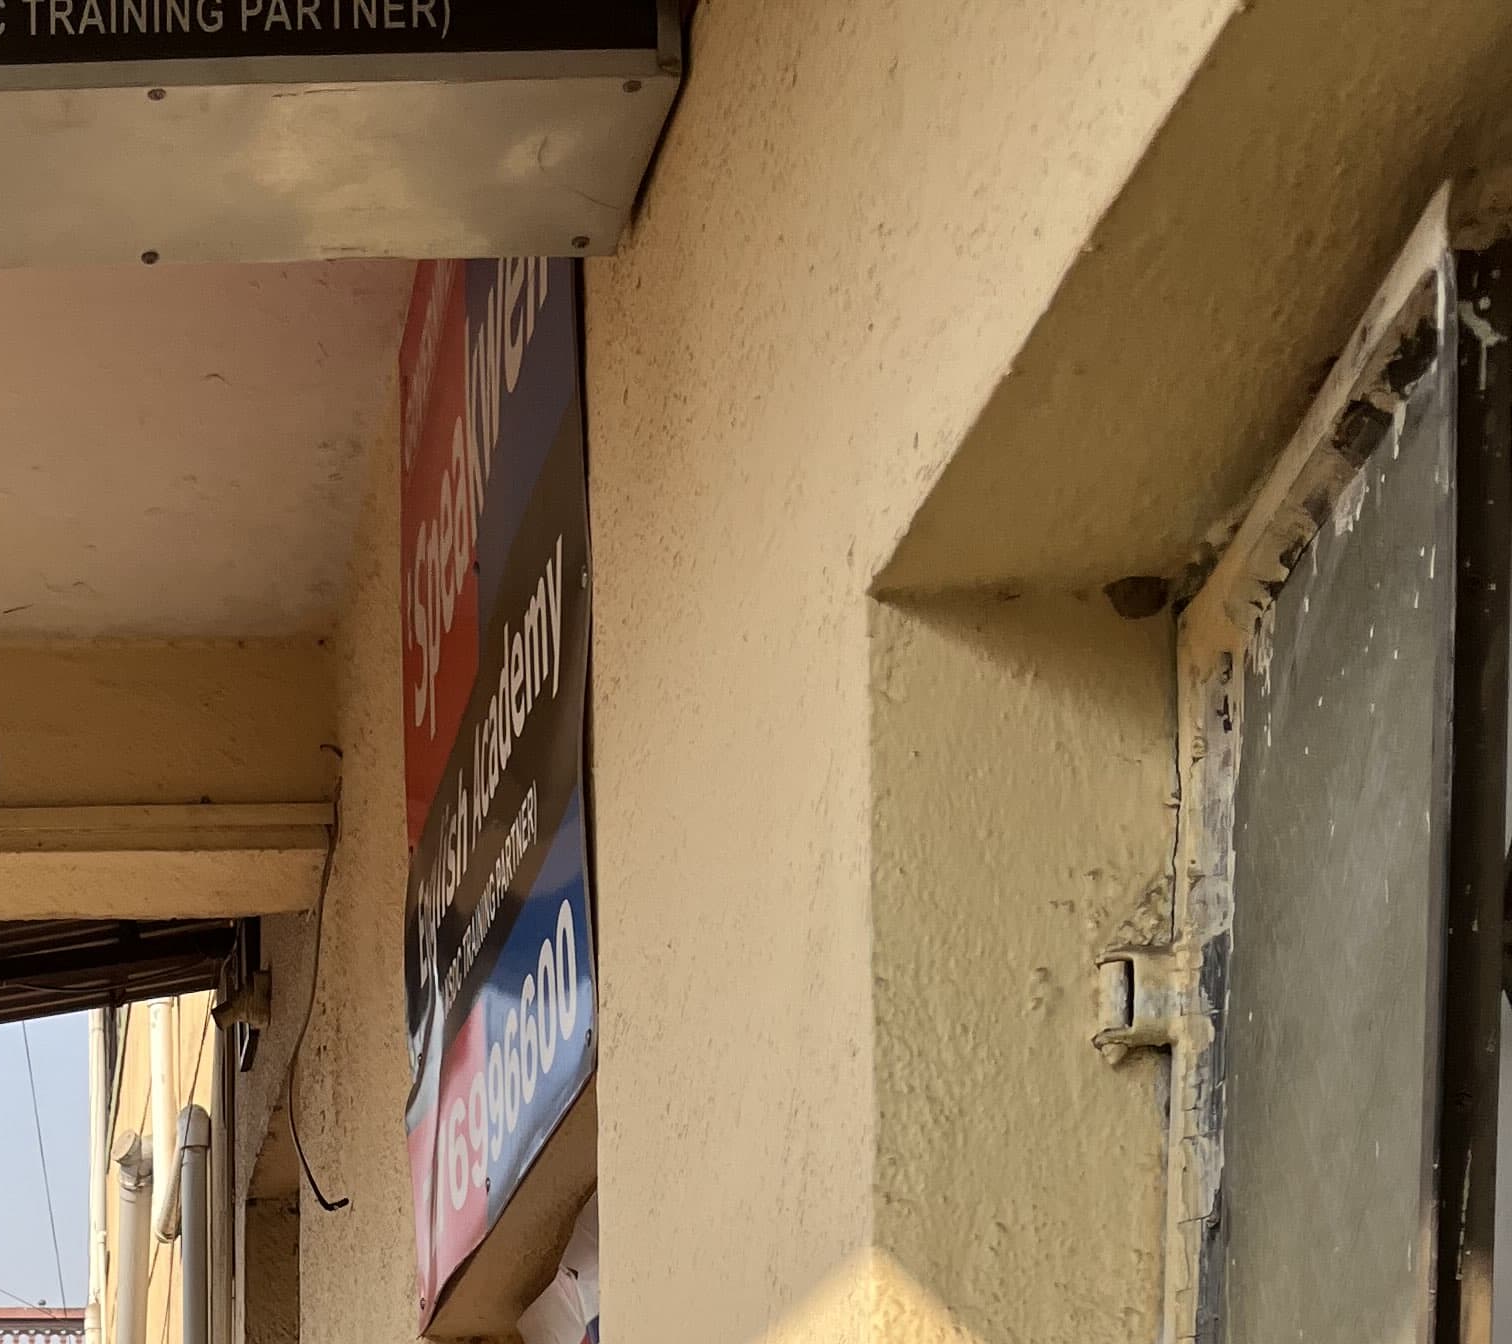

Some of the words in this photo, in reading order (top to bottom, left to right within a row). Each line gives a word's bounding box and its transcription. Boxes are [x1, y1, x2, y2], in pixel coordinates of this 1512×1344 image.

[23, 0, 224, 36] TRAINING
[241, 0, 450, 40] PARTNER)
[473, 533, 563, 853] Academy
[495, 779, 538, 908] PARTNER)
